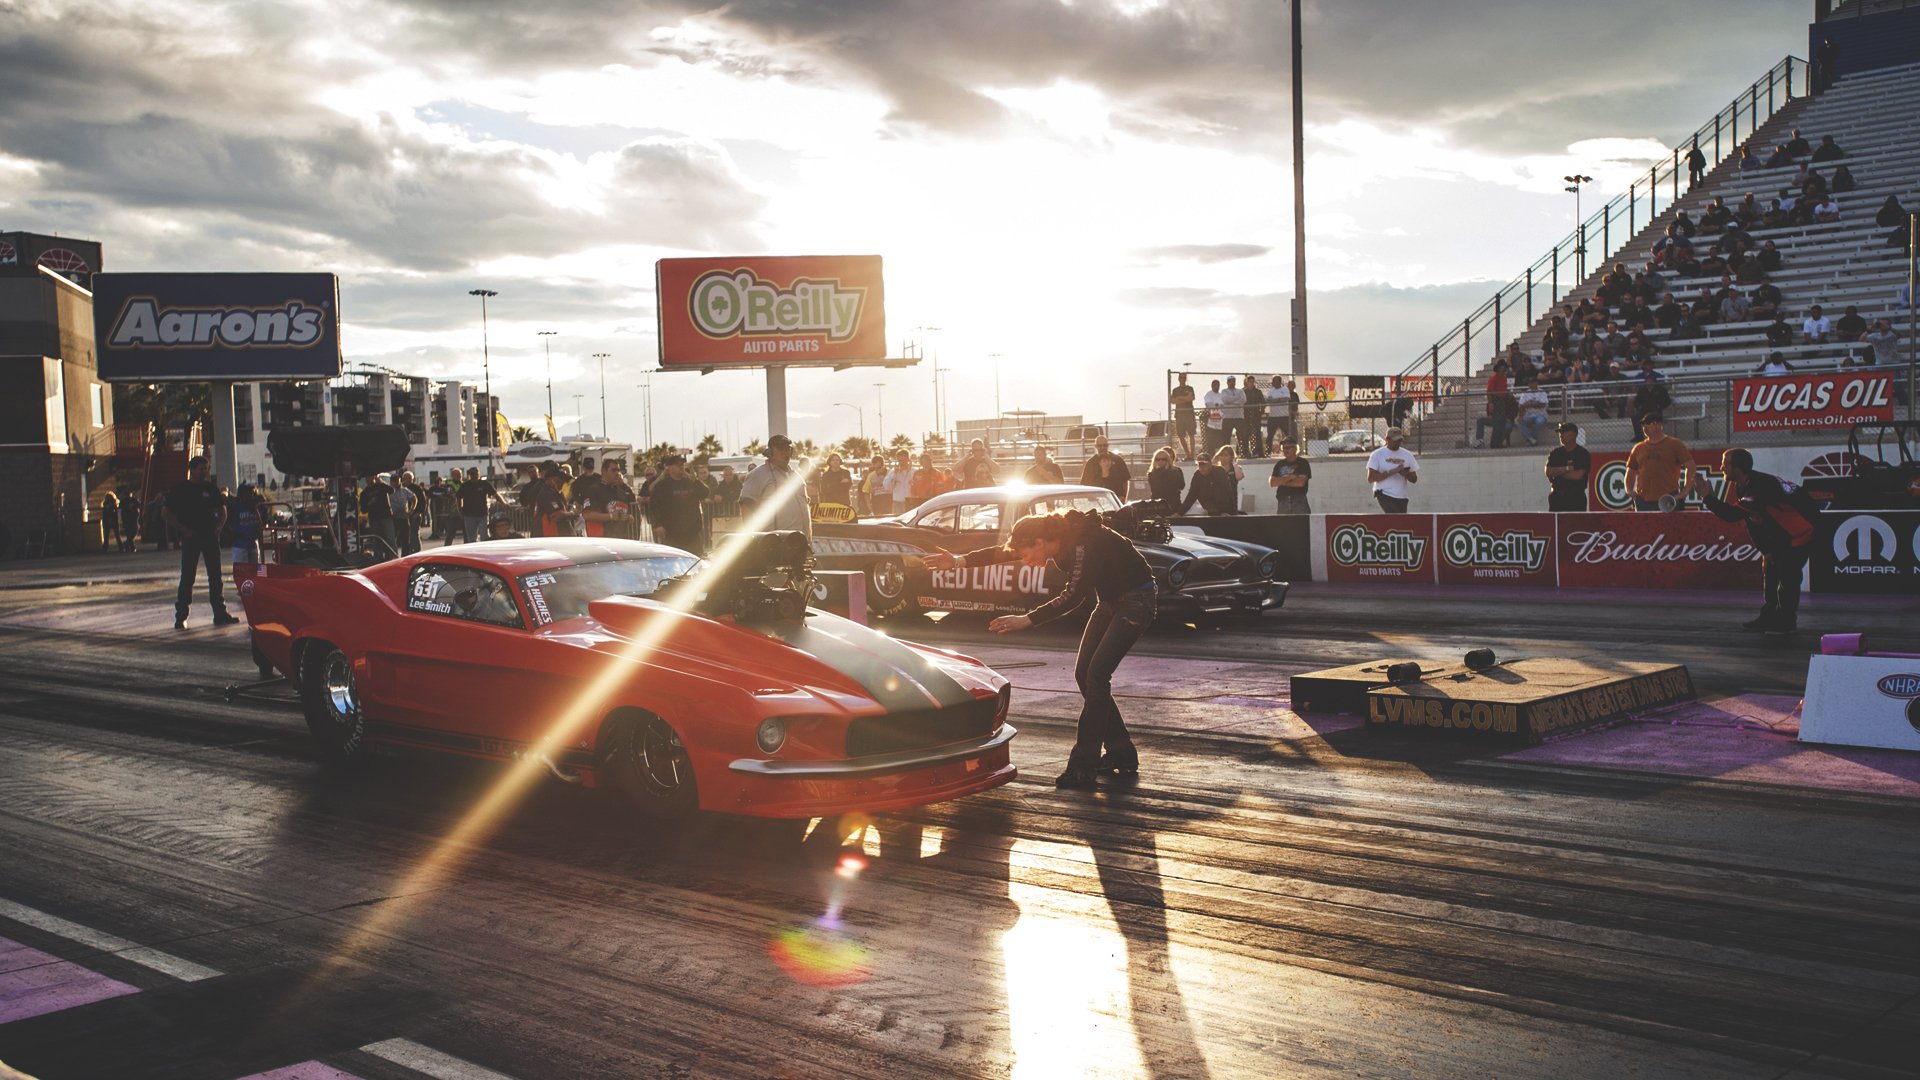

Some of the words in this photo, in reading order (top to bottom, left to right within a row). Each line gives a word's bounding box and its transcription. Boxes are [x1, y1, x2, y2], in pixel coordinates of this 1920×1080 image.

[696, 276, 857, 335] O'Reilly
[112, 301, 319, 344] Aaron's
[743, 340, 777, 354] AUTO
[779, 339, 820, 352] PARTS
[1351, 387, 1383, 401] ROSS
[1737, 380, 1834, 413] LUCAS
[1840, 377, 1889, 409] OIL
[1746, 414, 1878, 428] www.LucasOil.com
[811, 503, 851, 521] UNLIMITED
[1335, 527, 1425, 567] O'Reilly
[1446, 527, 1546, 570] O'Reilly
[931, 567, 968, 589] RED
[972, 564, 1013, 592] LINE
[1018, 564, 1049, 594] OIL
[1359, 567, 1378, 576] AUTO
[1378, 567, 1401, 576] PARTS
[1473, 568, 1494, 578] AUTO
[1494, 568, 1520, 578] PARTS
[1833, 565, 1897, 574] MOPAR
[414, 580, 440, 599] 631
[409, 597, 425, 609] Lee
[424, 600, 452, 614] Smith
[530, 588, 553, 623] HUGHES
[1369, 695, 1518, 733] LVMS.COM
[1528, 693, 1587, 733] AMERICA'S
[1582, 682, 1637, 721] GREATEST
